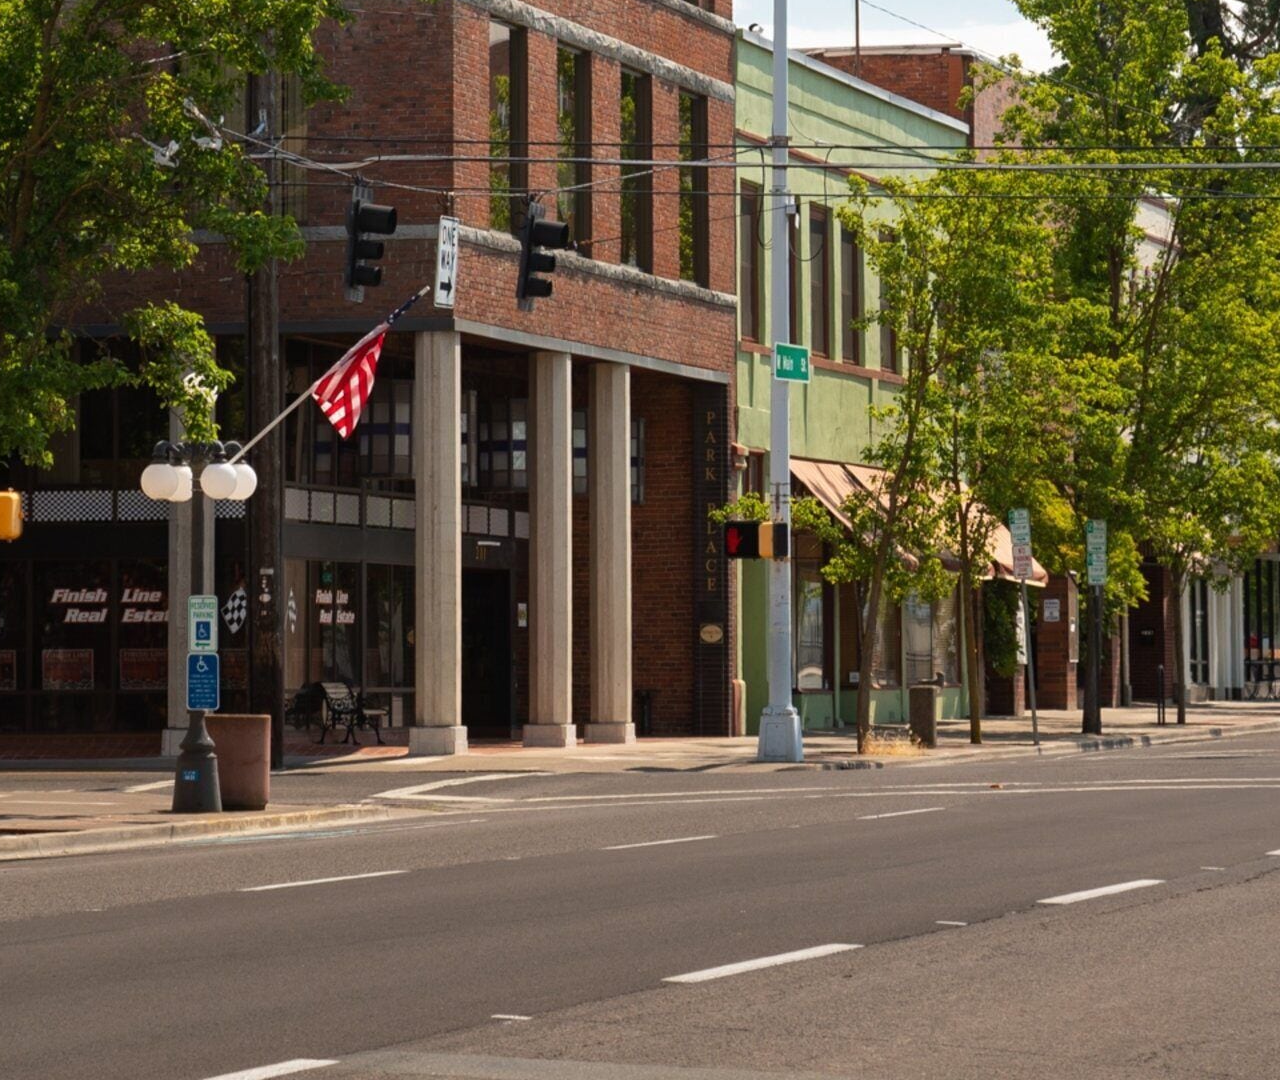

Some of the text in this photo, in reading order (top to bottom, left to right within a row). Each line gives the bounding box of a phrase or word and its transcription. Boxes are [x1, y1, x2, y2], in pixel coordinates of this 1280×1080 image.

[442, 225, 456, 247] ONE
[440, 249, 456, 270] WAY
[704, 411, 717, 481] PARK
[50, 588, 162, 602] Finish Line
[63, 608, 169, 622] Real Estat
